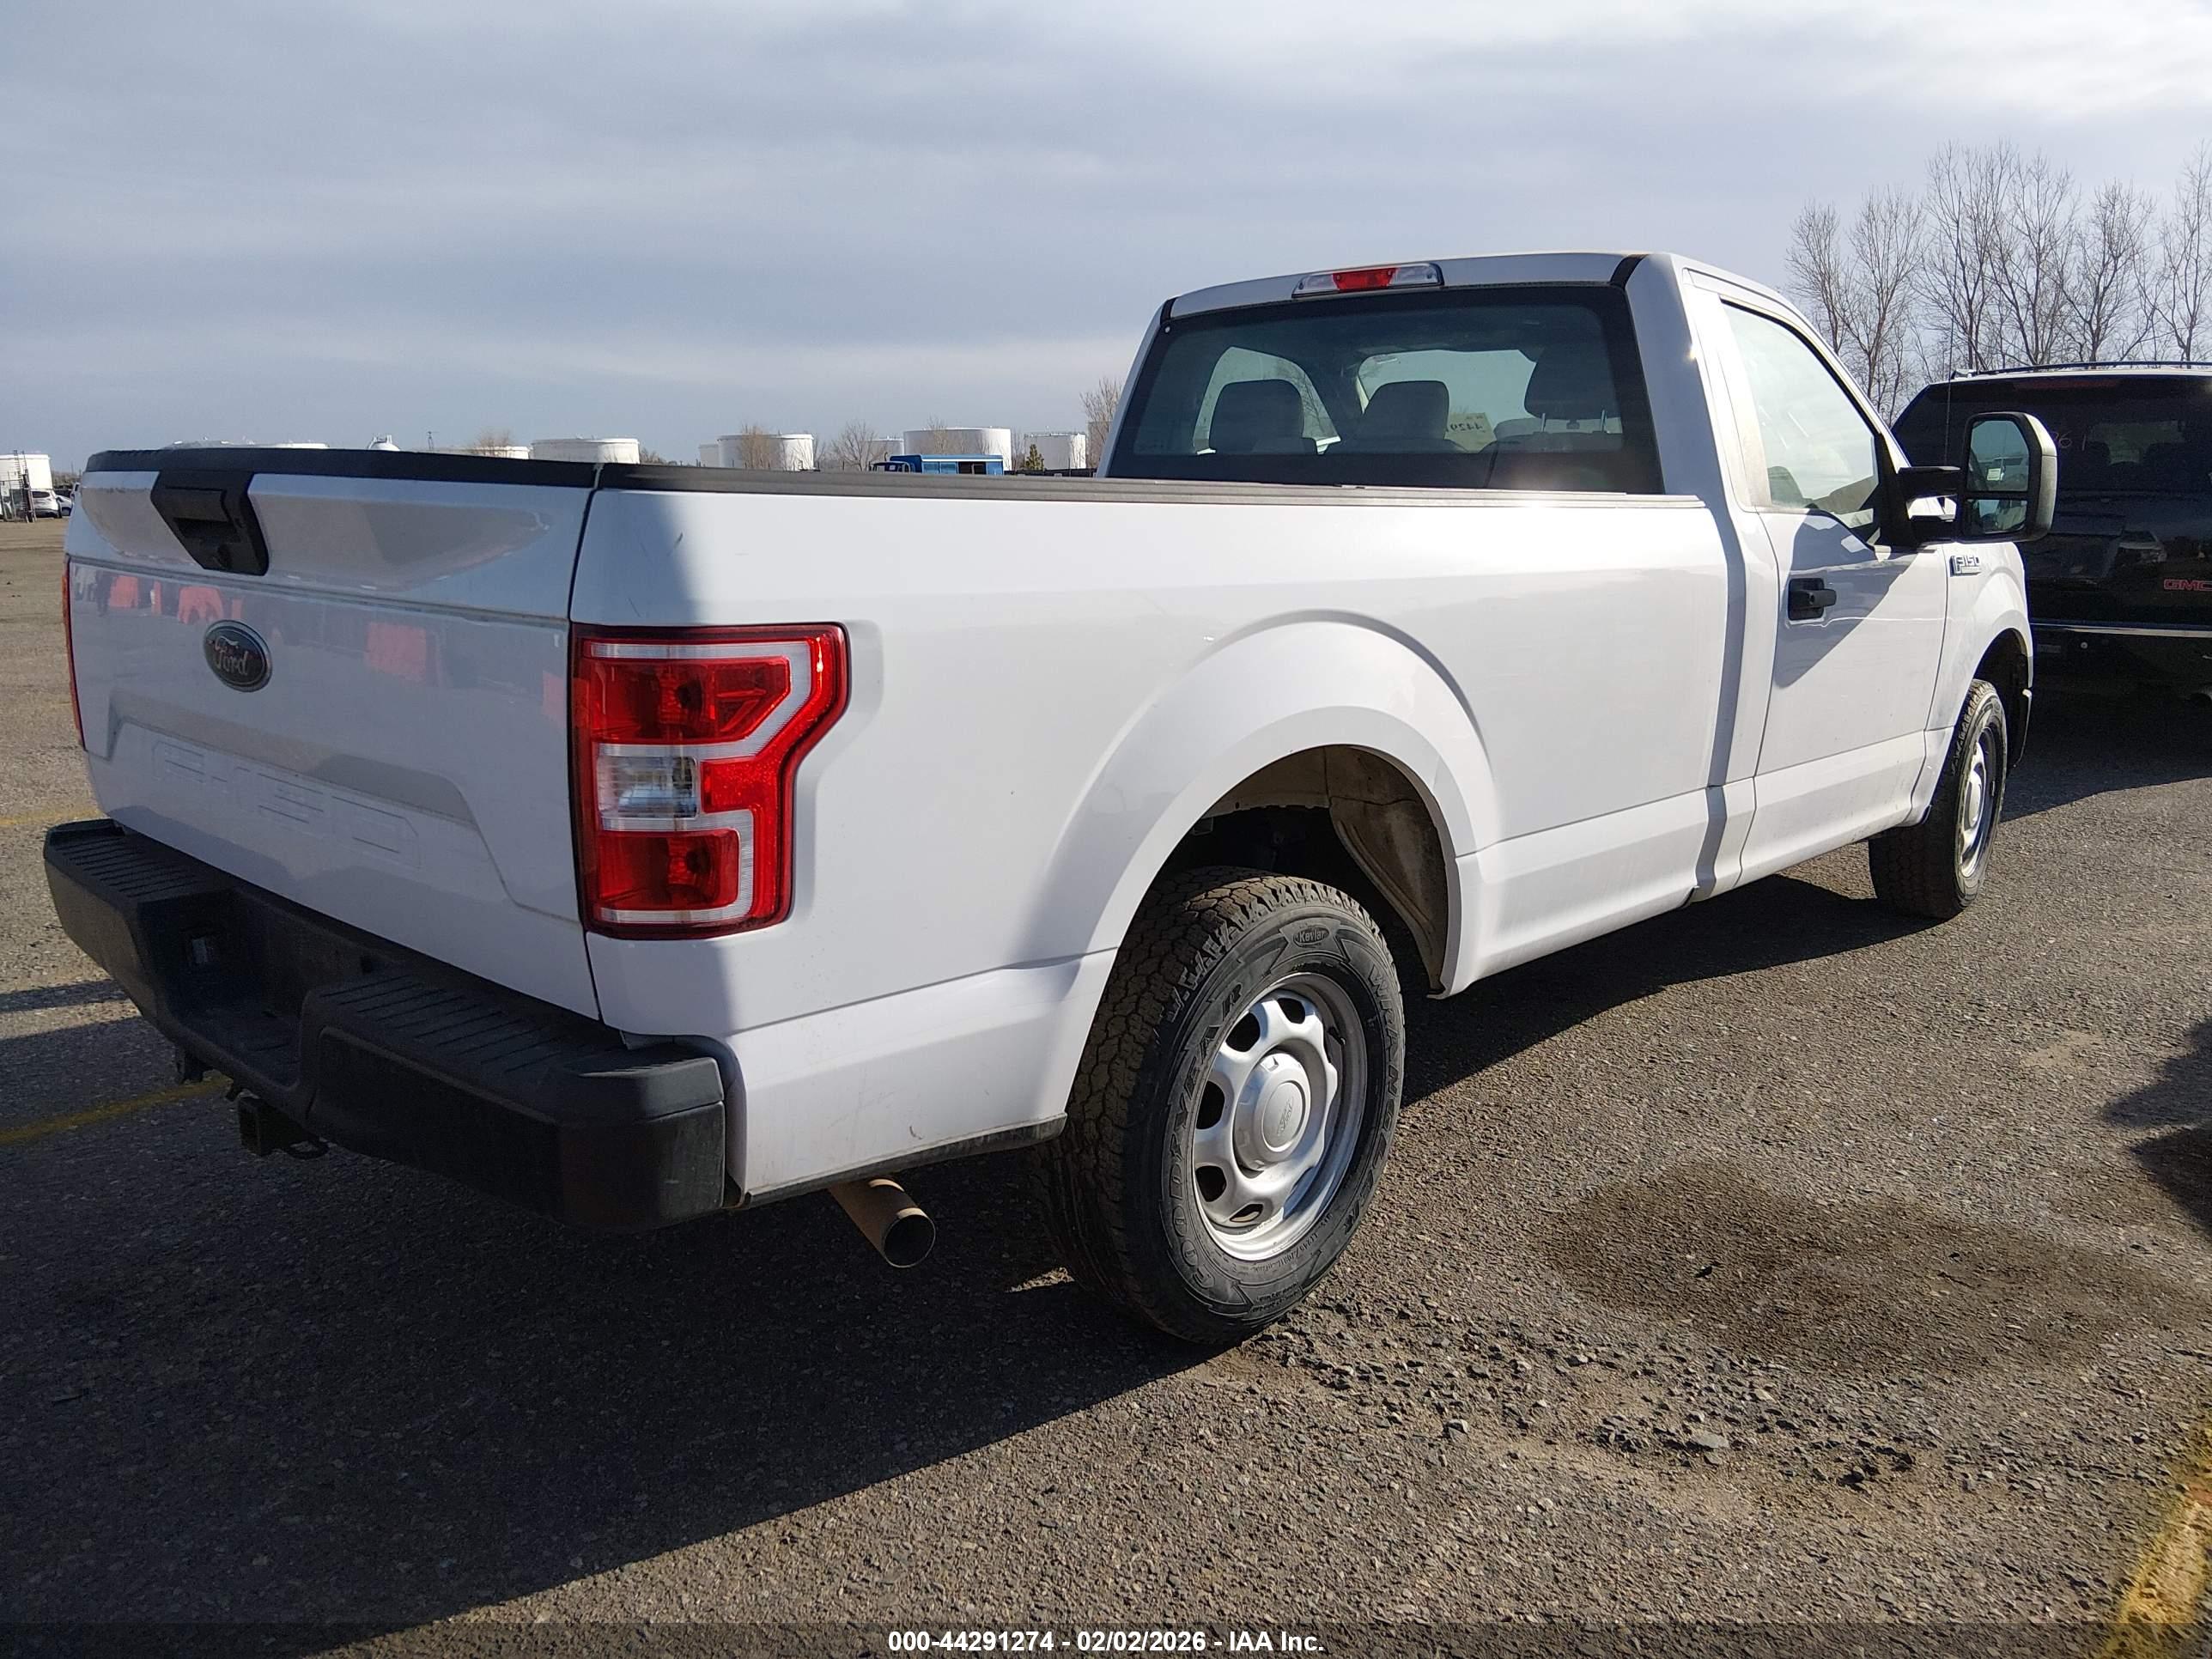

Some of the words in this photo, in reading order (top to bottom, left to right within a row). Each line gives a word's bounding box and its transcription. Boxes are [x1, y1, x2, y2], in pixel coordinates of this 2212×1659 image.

[214, 635, 249, 676] Ford
[1299, 928, 1327, 943] Kevlar
[1170, 981, 1243, 1290] GOODYEAR
[1344, 963, 1402, 1237] WRANGLER
